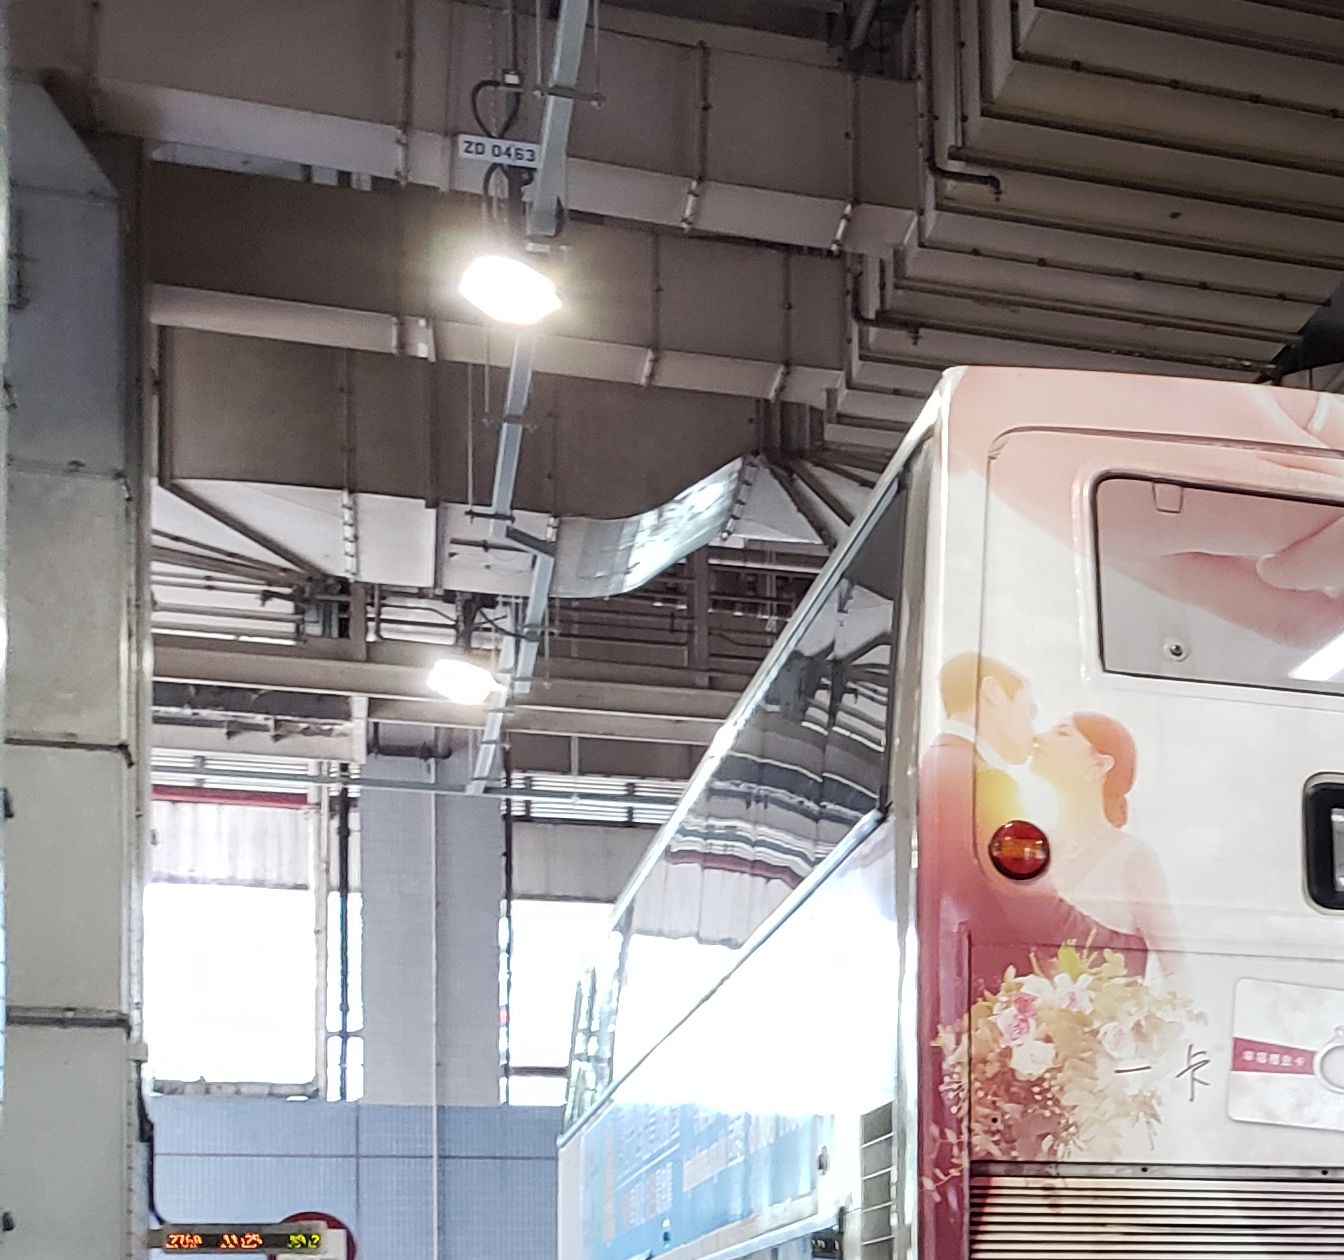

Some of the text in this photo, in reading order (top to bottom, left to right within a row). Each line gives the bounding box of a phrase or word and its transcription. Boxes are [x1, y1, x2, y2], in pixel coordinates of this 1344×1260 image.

[463, 140, 536, 162] ZD 0463
[1114, 1044, 1211, 1102] 一卡
